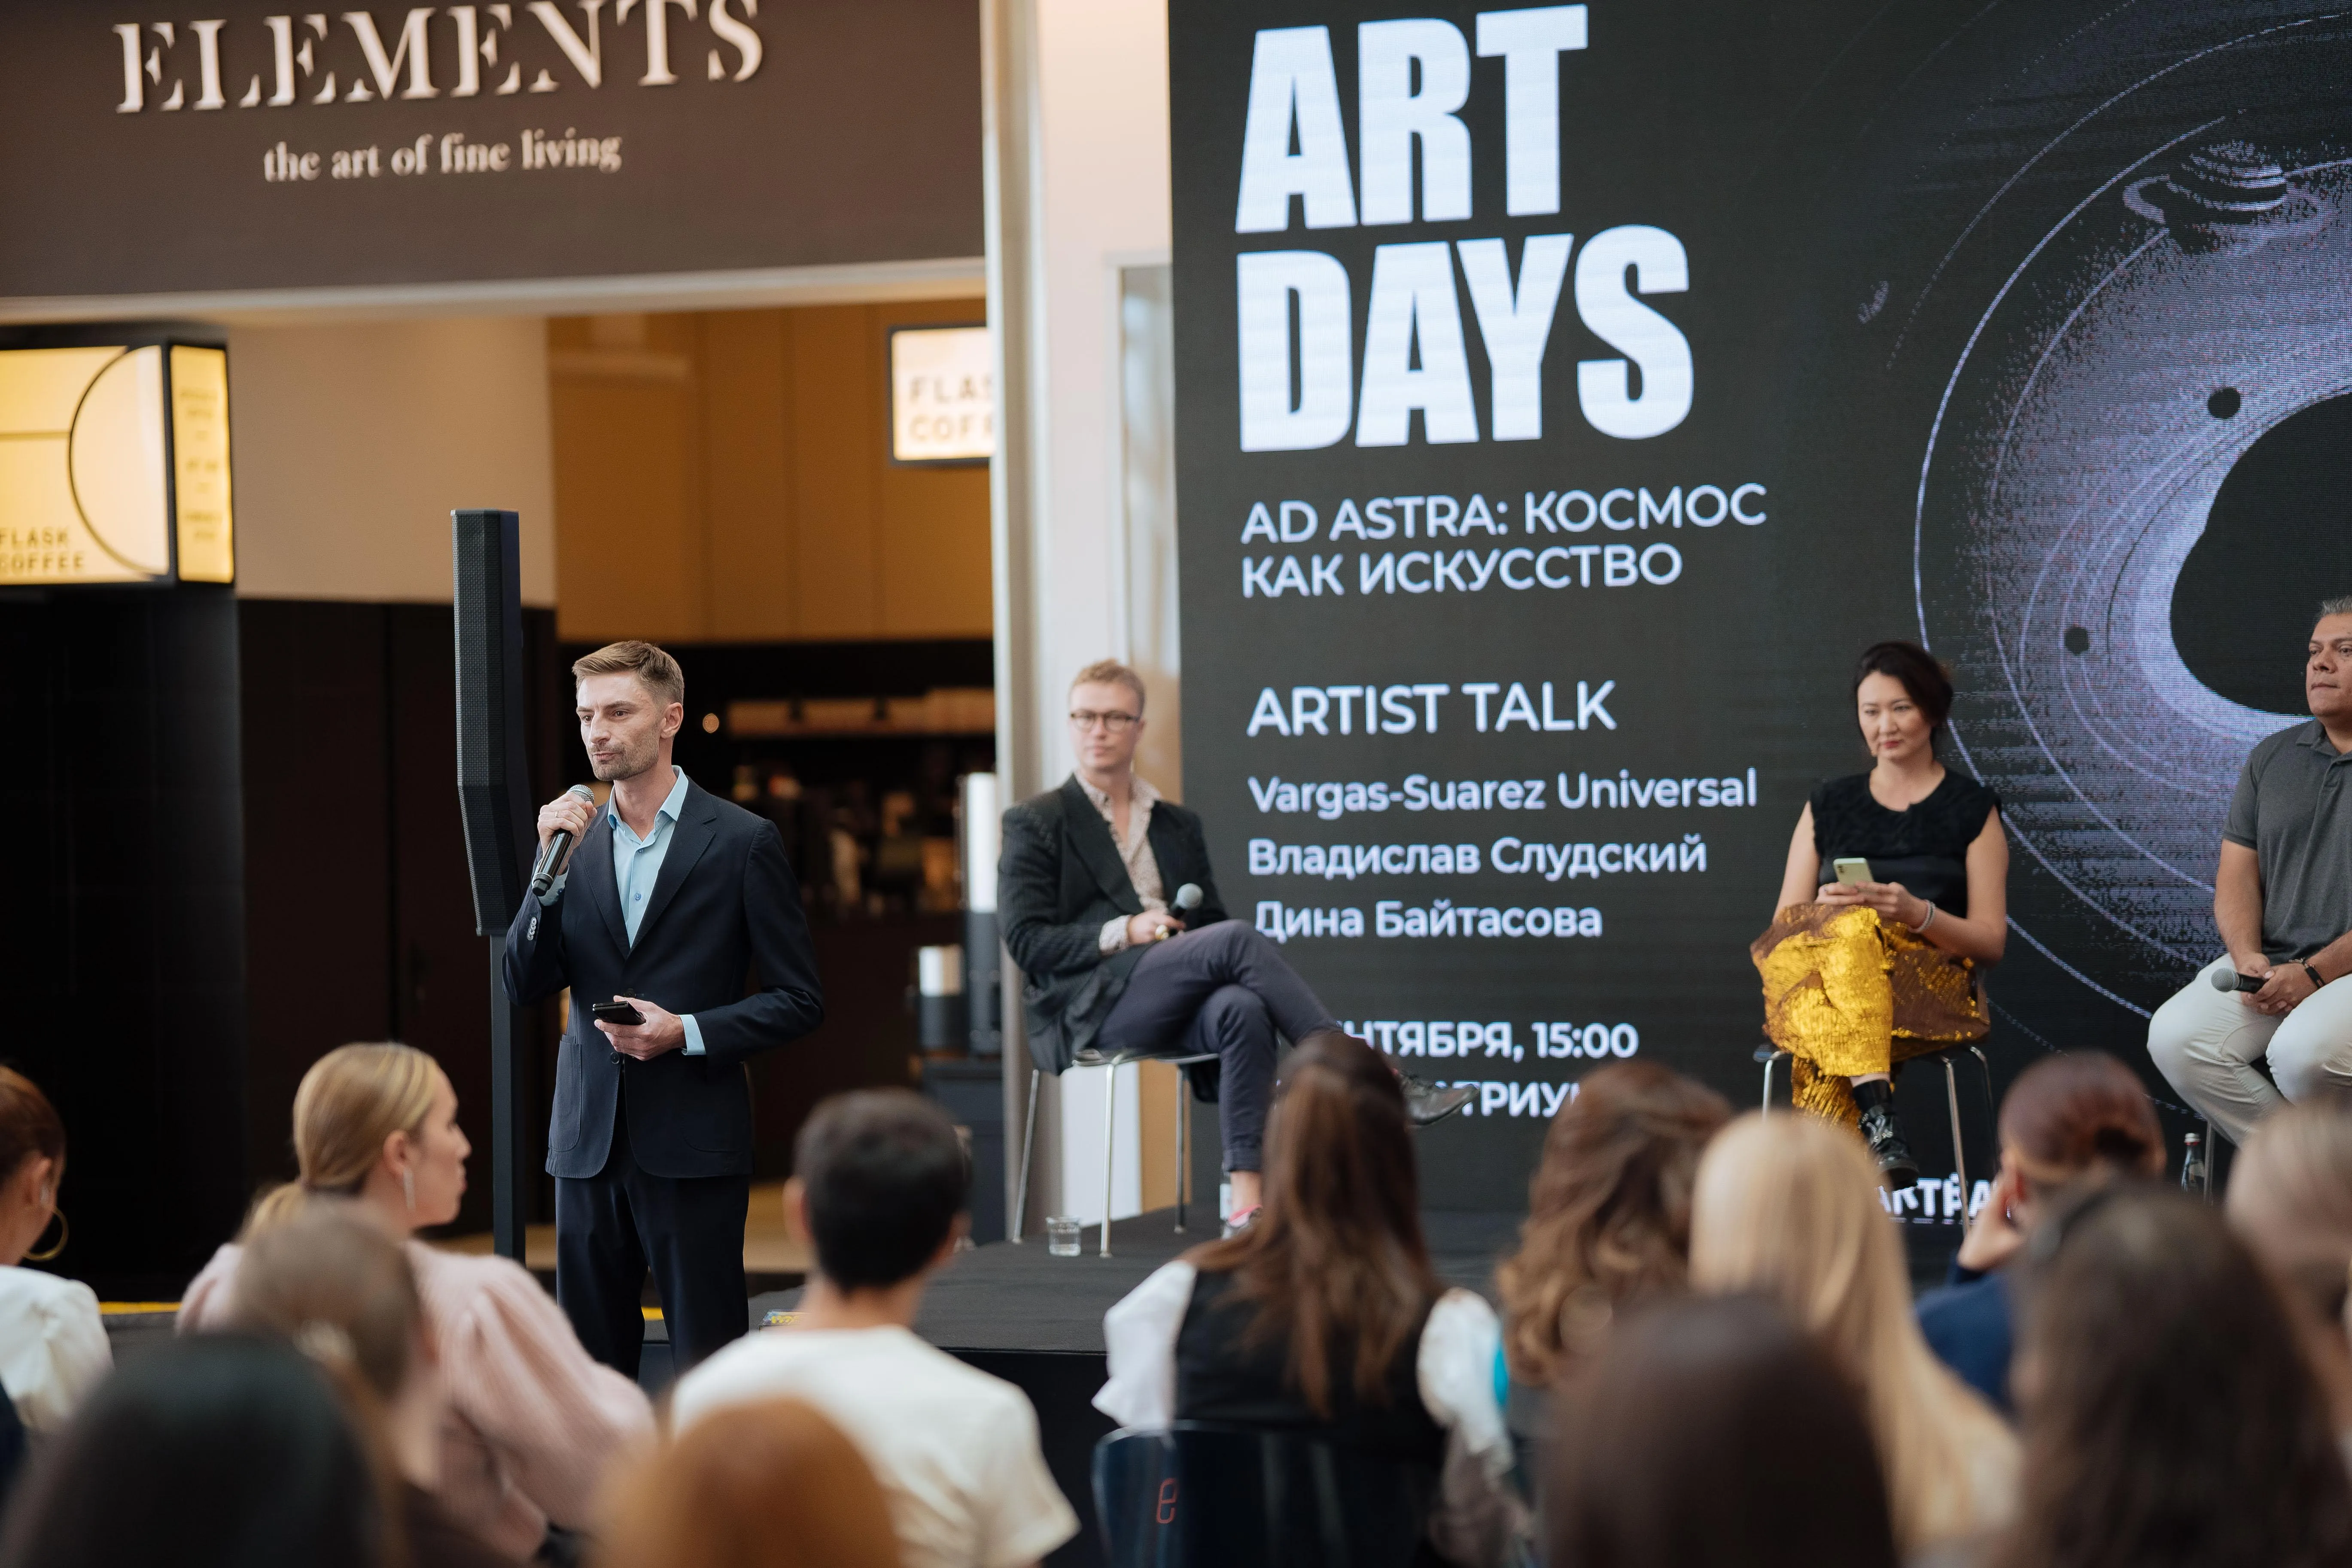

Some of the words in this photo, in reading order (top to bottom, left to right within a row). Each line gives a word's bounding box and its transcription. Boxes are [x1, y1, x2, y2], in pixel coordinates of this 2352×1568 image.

[115, 0, 763, 113] ELEMENTS
[1235, 4, 1589, 233] ART
[264, 141, 321, 183] the
[331, 145, 380, 179] art
[391, 134, 433, 176] of
[440, 132, 511, 173] fine
[521, 127, 623, 173] living
[1236, 224, 1695, 453] DAYS
[1240, 501, 1319, 545] AD
[1328, 494, 1509, 542] ASTRA:
[1524, 483, 1767, 534] КОСМОС
[1242, 554, 1345, 599] КАК
[1359, 543, 1683, 595] ИСКУССТВО
[1247, 684, 1451, 737] ARTIST
[1460, 681, 1617, 733] TALK
[1248, 773, 1546, 820] Vargas-Suarez
[1558, 767, 1757, 810] Universal
[1248, 839, 1481, 880] Владислав
[1490, 834, 1707, 882] Слудский
[1255, 901, 1364, 944] Дина
[1375, 899, 1603, 938] Байтасова
[1531, 1022, 1640, 1059] 15:00
